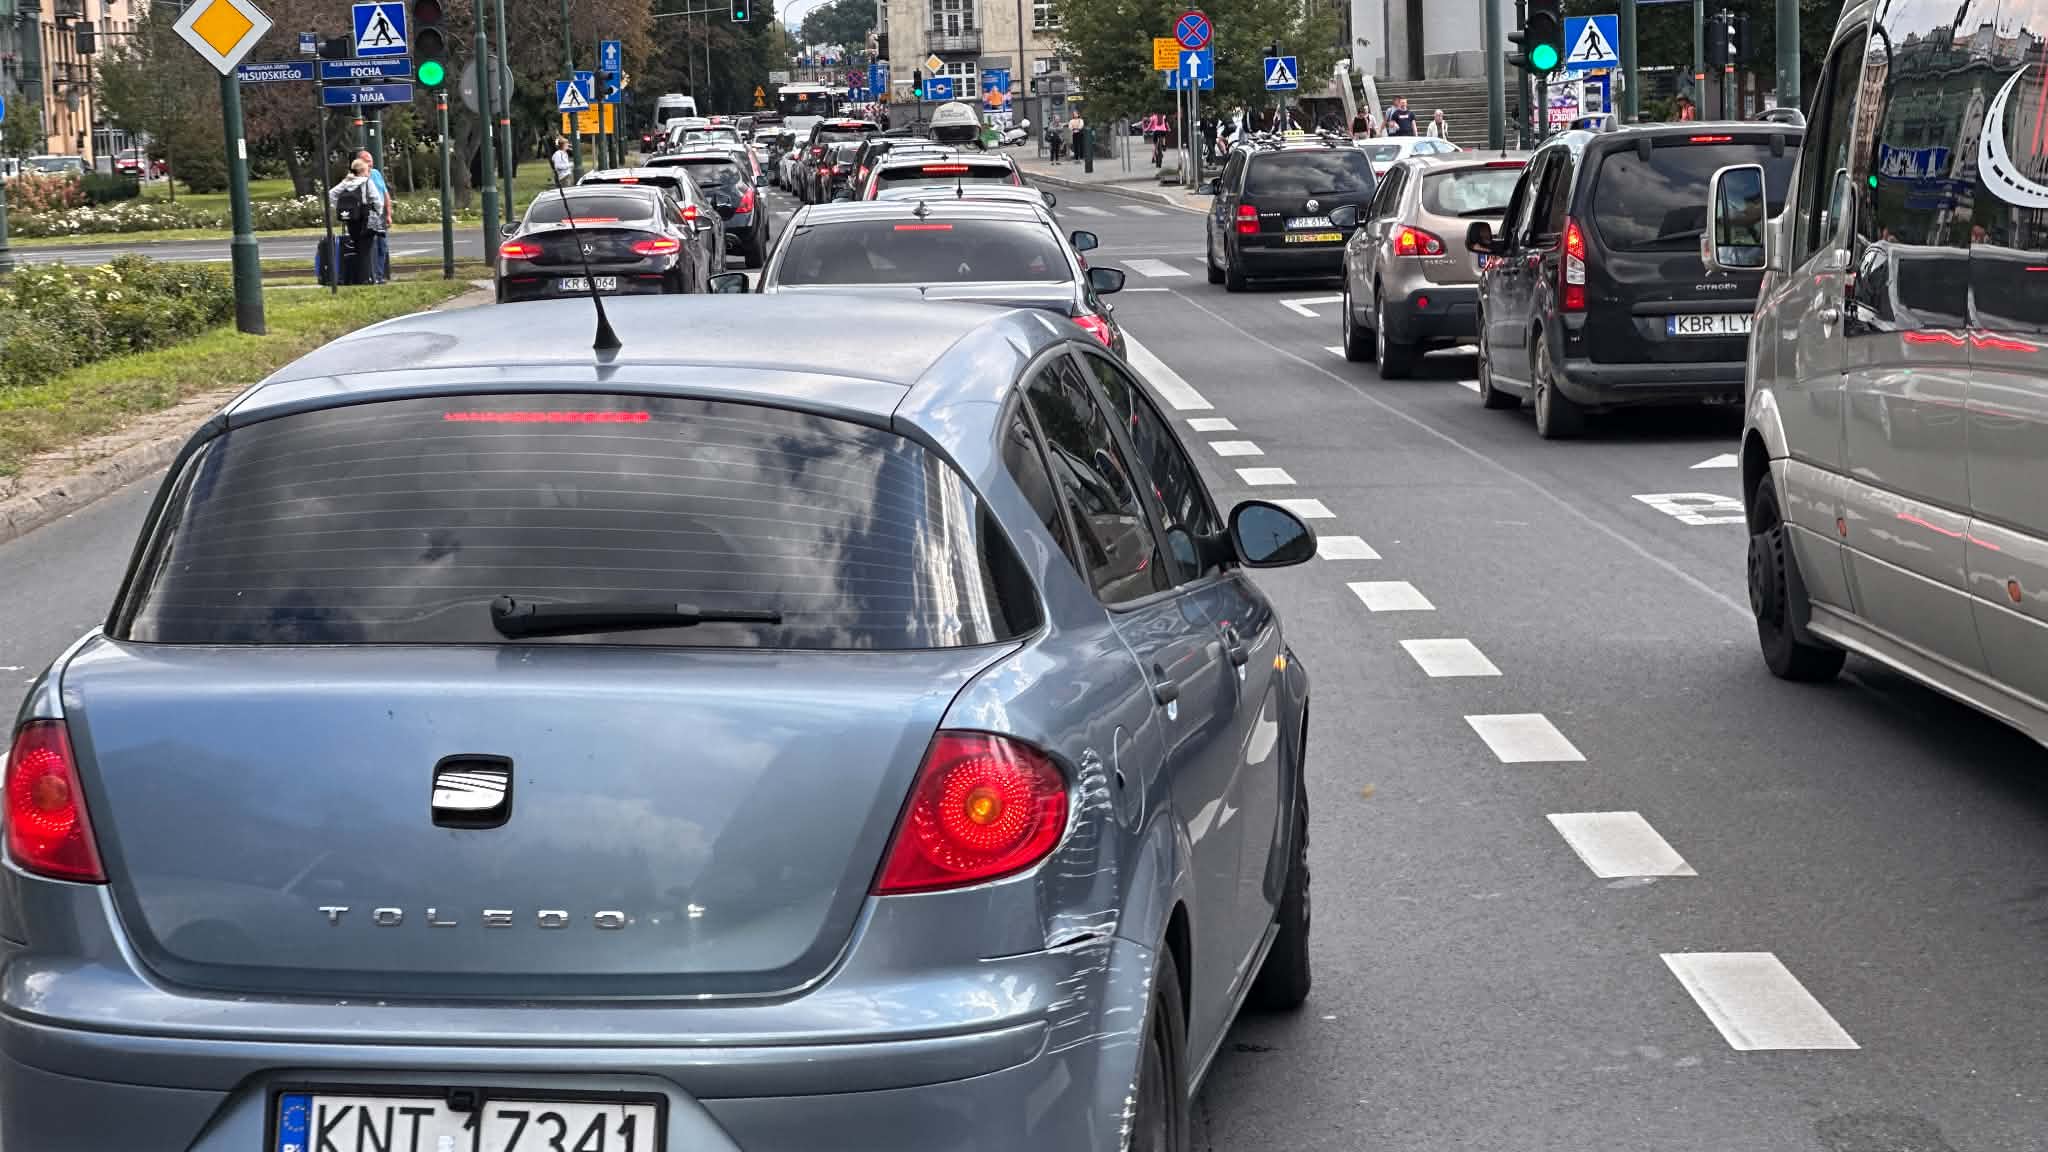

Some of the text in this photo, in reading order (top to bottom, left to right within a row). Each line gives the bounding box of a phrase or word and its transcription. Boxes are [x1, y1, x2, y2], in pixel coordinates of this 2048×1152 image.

[351, 67, 382, 77] FOCHA
[351, 93, 385, 103] 3 MAJA
[1678, 316, 1713, 332] KBR
[1721, 315, 1752, 331] 1LY
[319, 906, 625, 929] TOLEDO
[317, 1104, 637, 1152] KNT 17341
